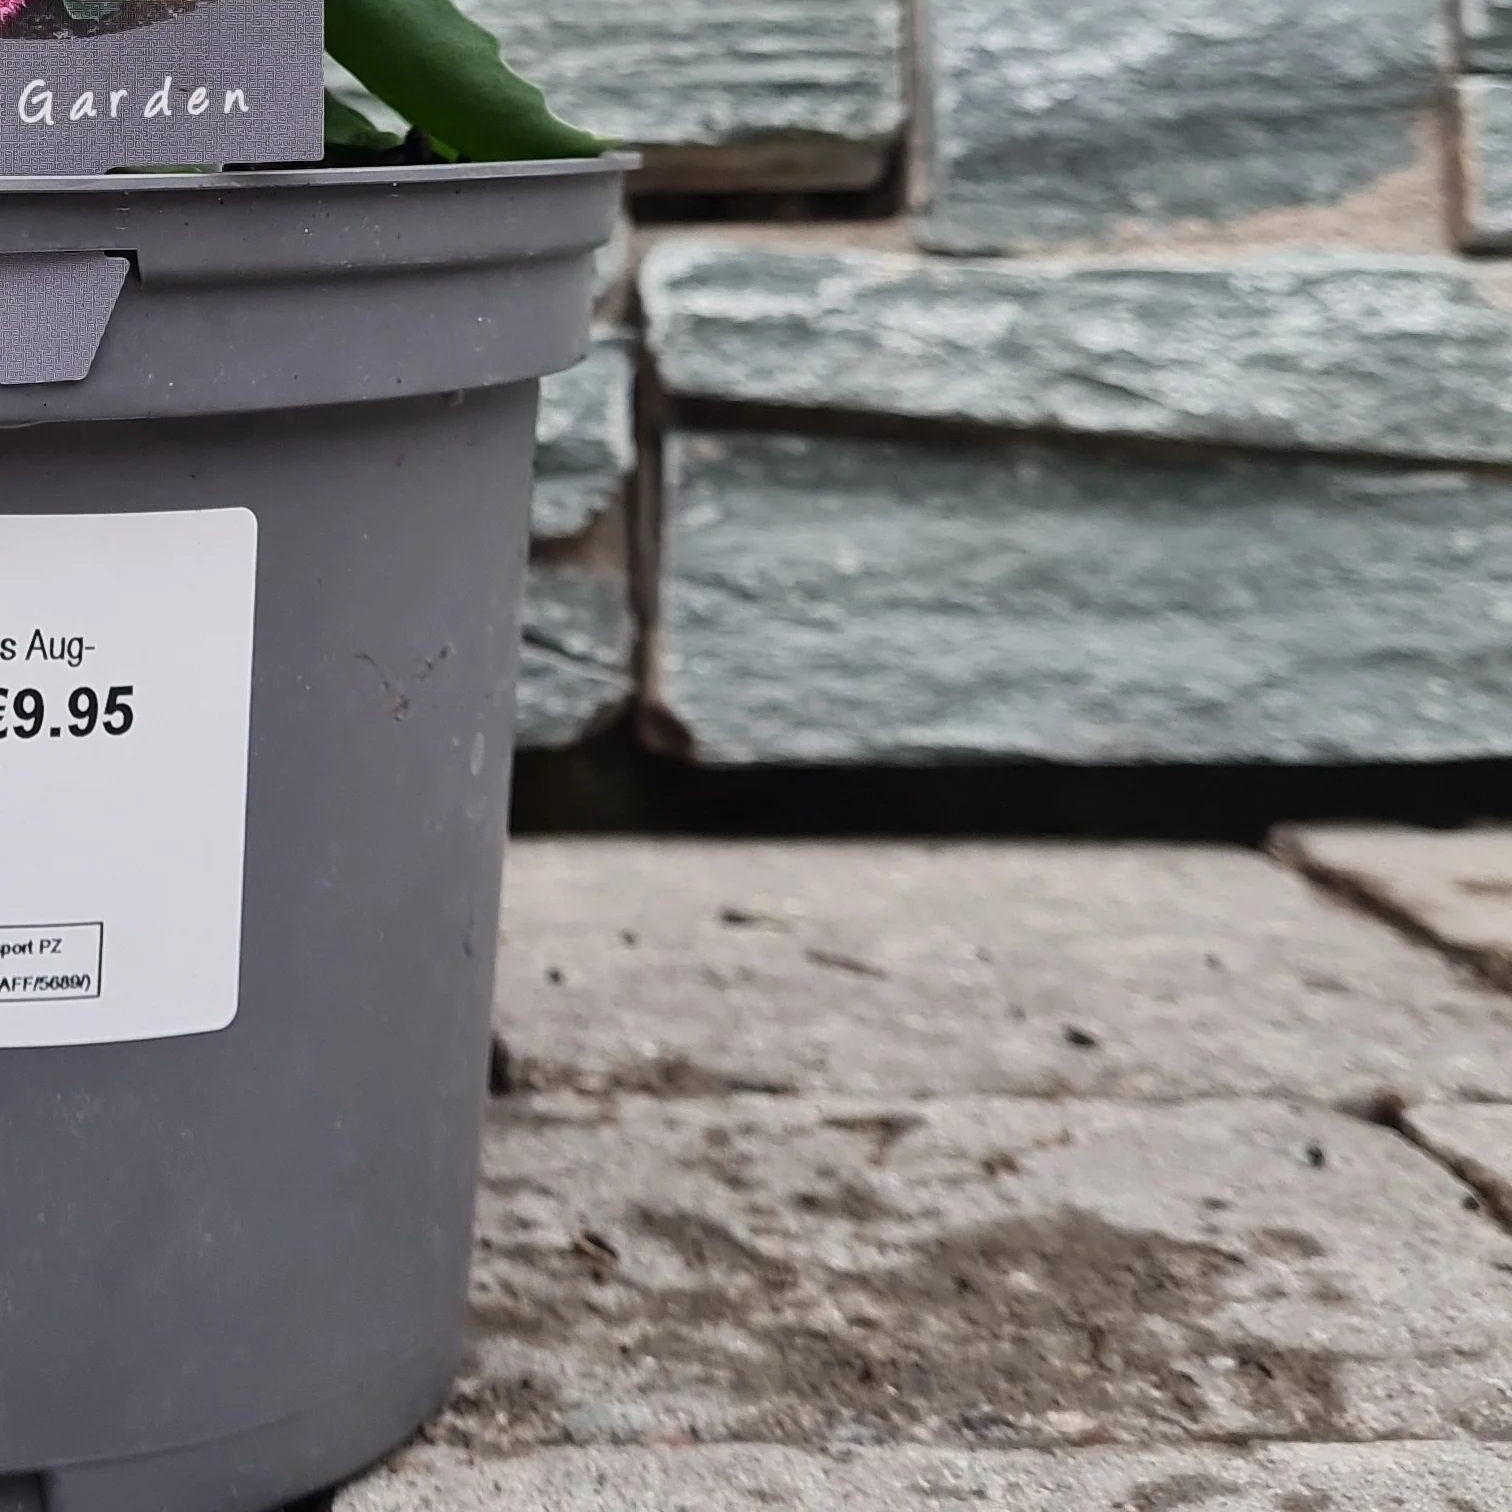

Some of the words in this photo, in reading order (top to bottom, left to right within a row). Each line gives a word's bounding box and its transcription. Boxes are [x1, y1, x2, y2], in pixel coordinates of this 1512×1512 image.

[17, 75, 250, 126] Garden
[24, 628, 95, 667] Aug-
[39, 938, 63, 954] PZ
